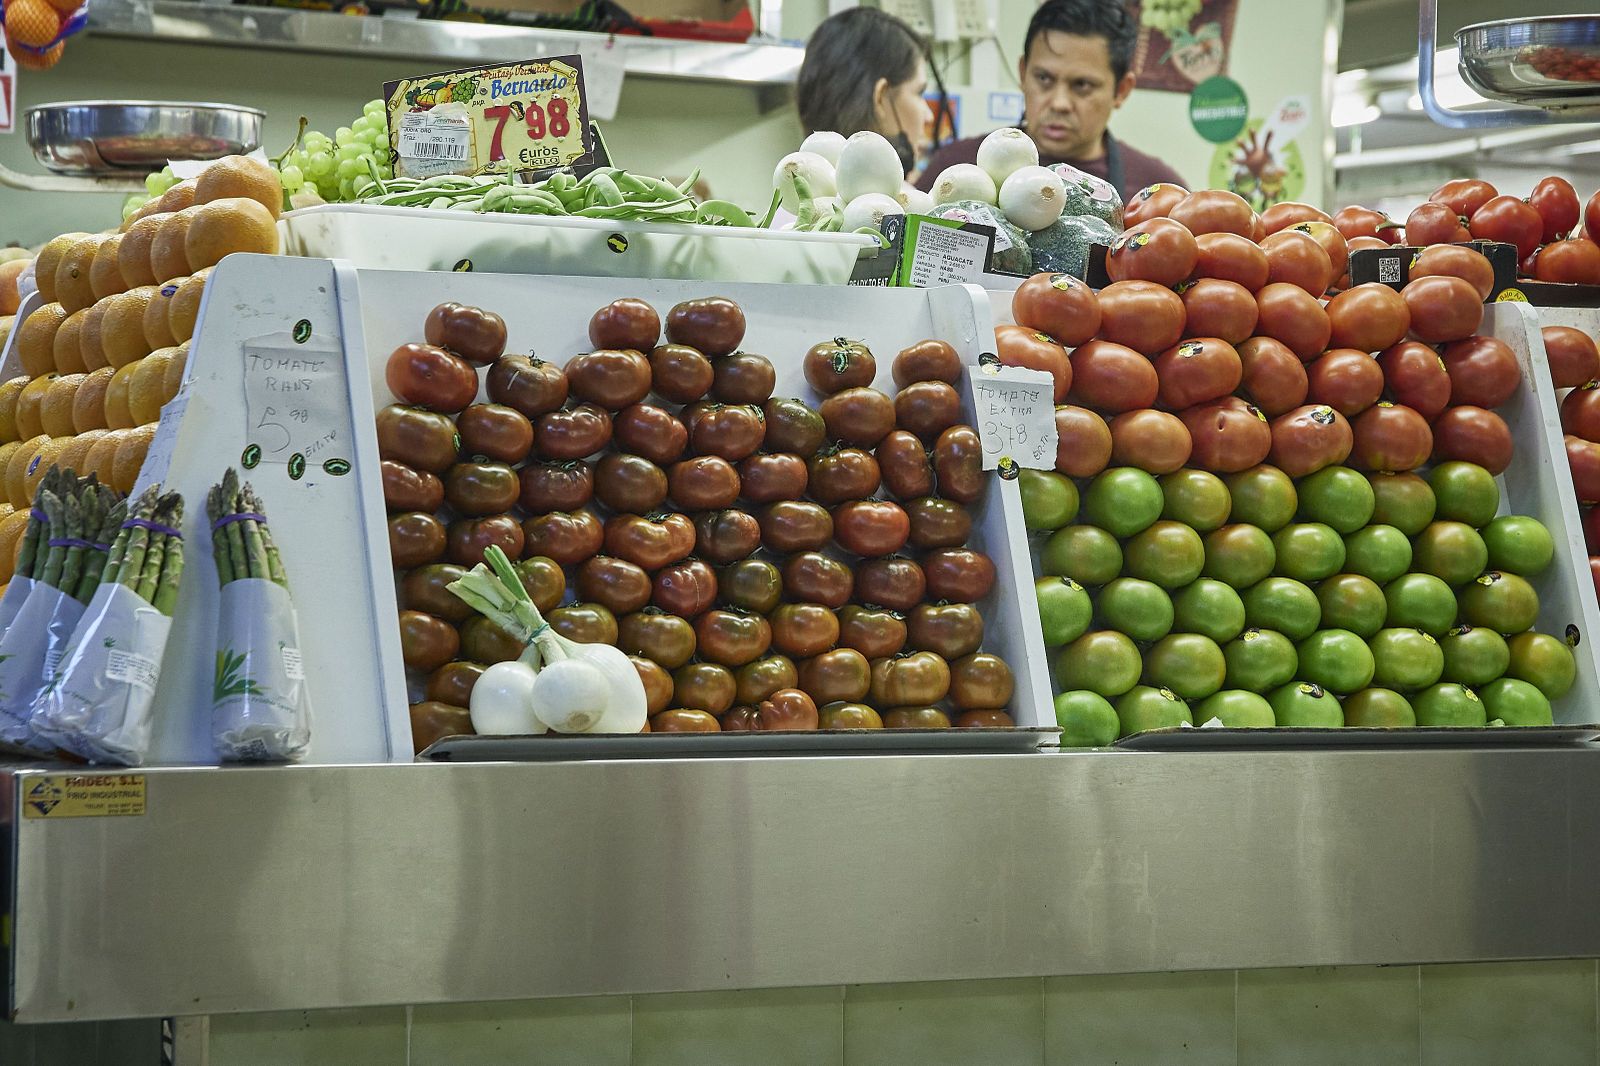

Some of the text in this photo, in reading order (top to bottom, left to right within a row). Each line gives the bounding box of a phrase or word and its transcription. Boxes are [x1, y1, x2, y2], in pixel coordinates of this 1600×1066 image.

[491, 74, 567, 99] Bernardo
[942, 254, 974, 266] AGUACATE
[868, 278, 877, 287] TO
[877, 278, 889, 287] EAT
[248, 354, 325, 373] TOMATE
